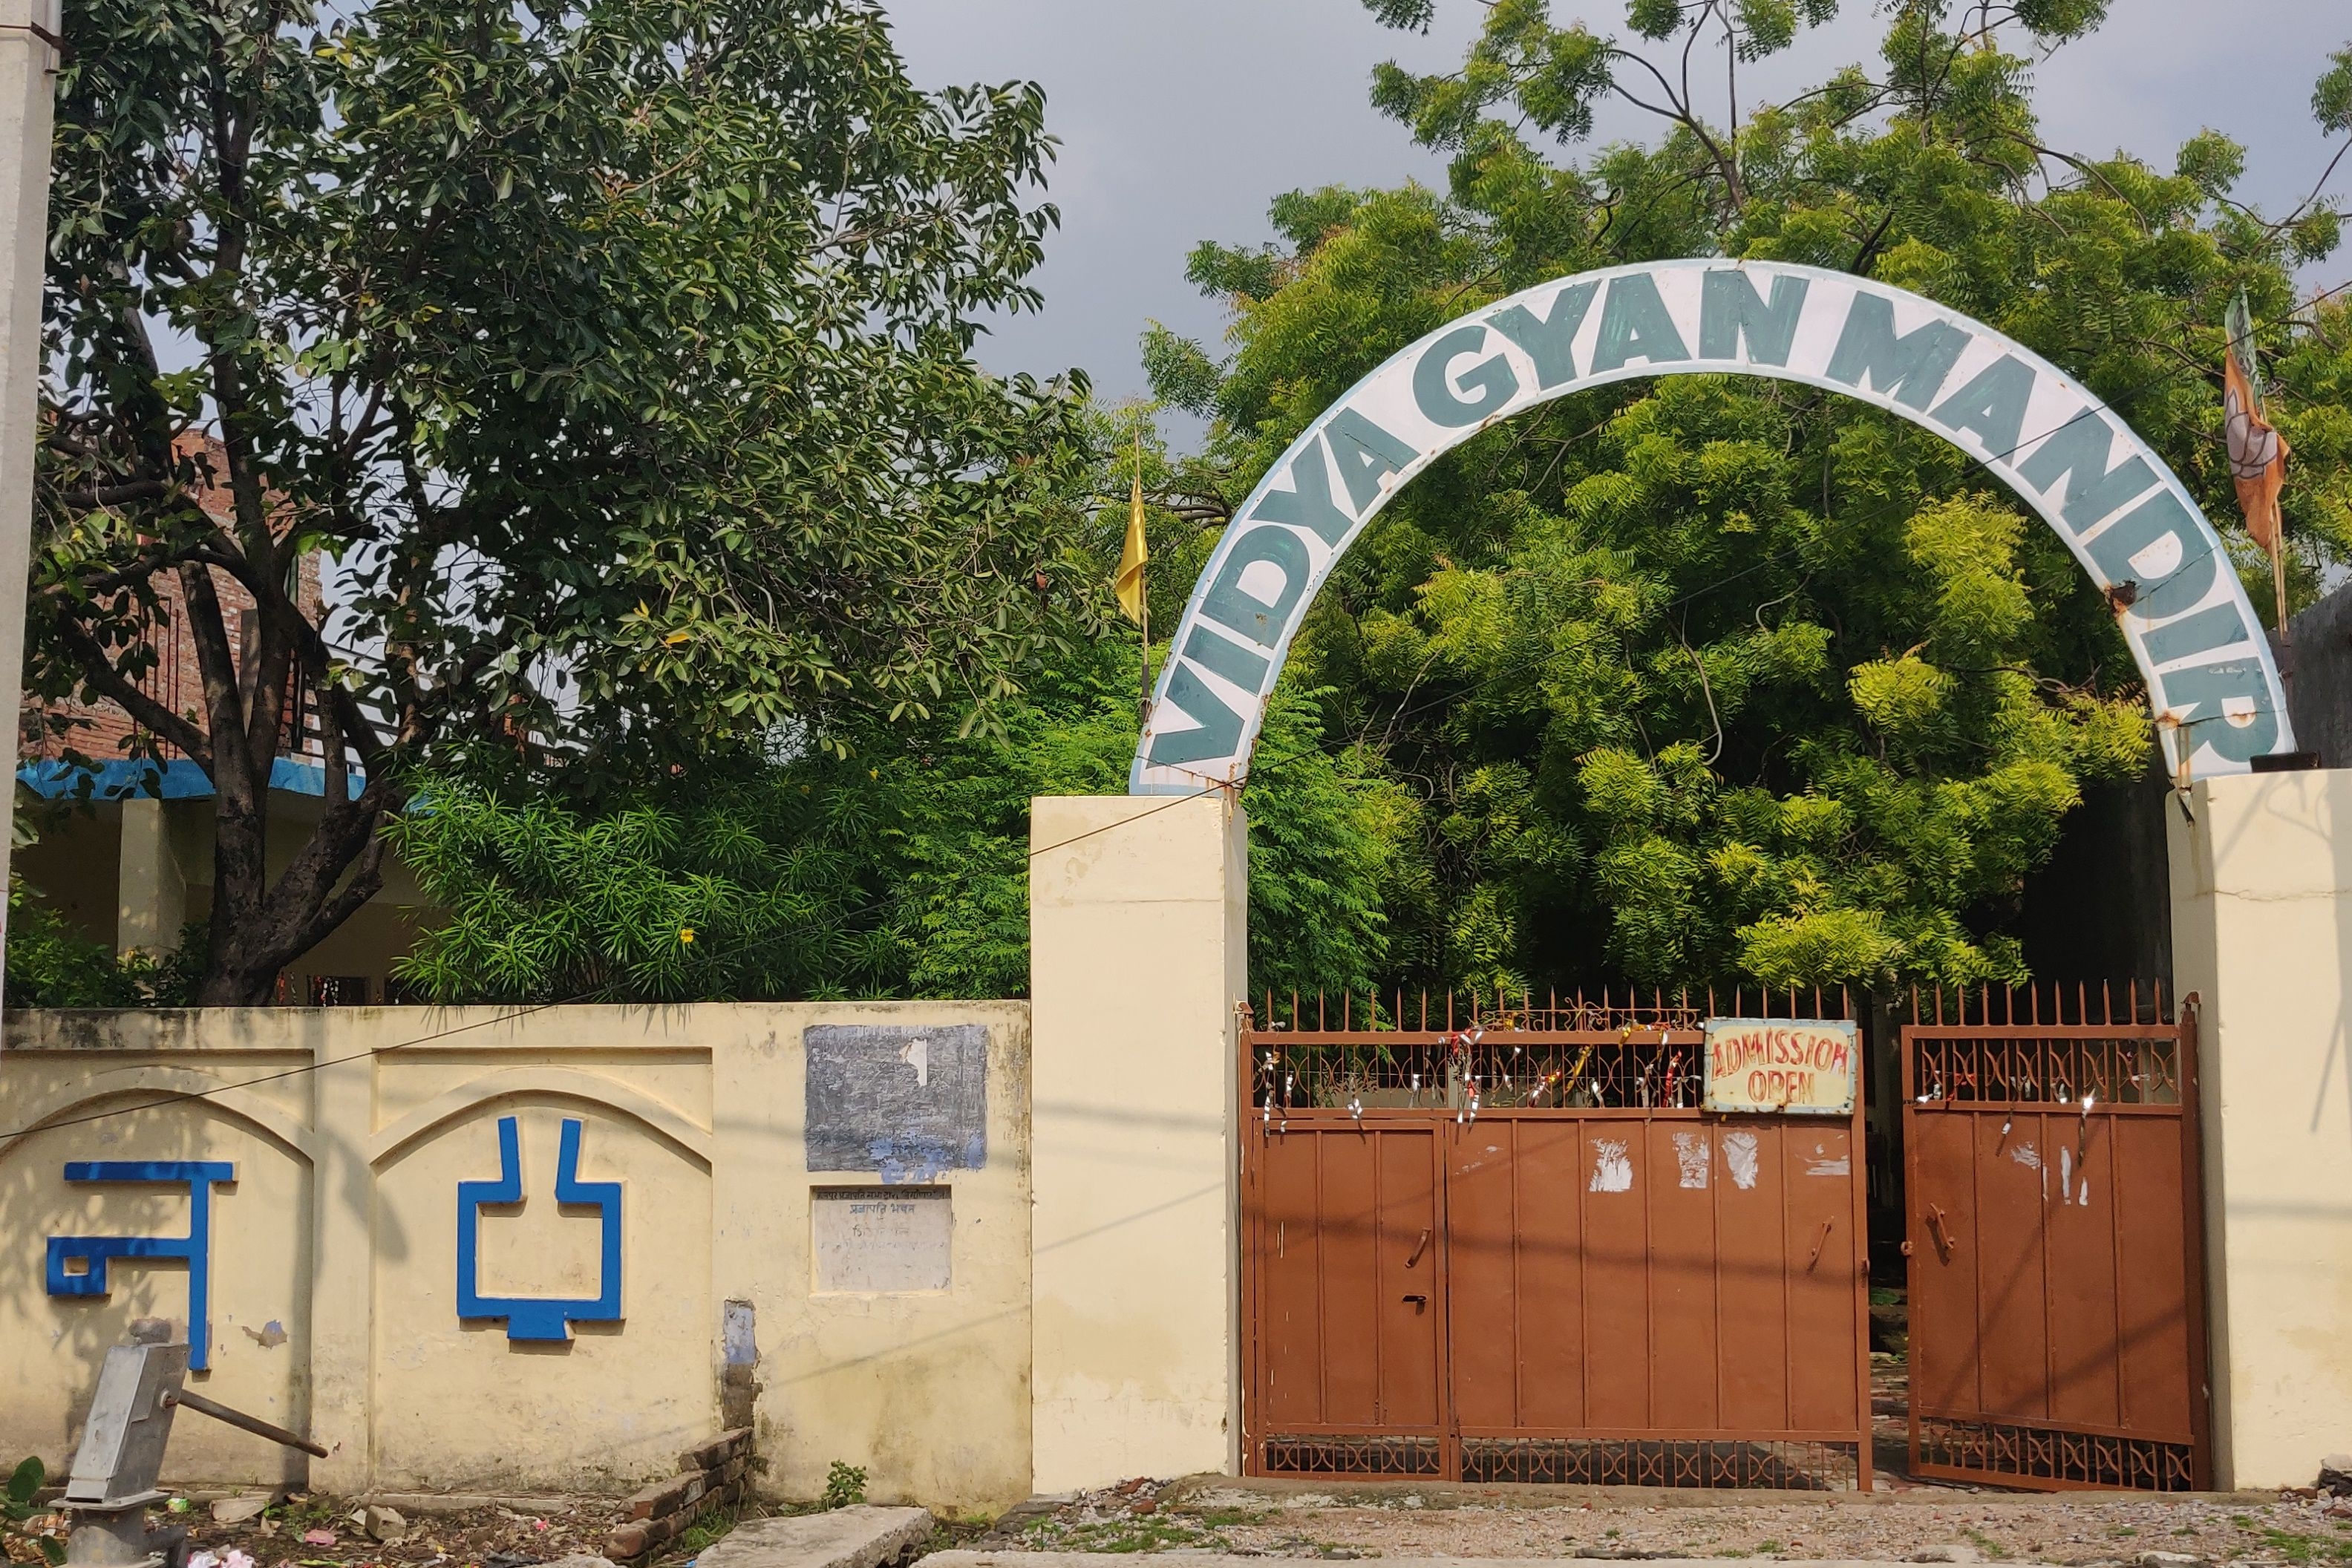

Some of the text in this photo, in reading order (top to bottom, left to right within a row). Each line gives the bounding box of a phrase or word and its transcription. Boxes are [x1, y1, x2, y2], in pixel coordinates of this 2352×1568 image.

[1146, 270, 2278, 770] VIDYA GYAN MANDIR
[1711, 1028, 1849, 1082] ADMISSION
[1747, 1070, 1815, 1103] OPEN
[849, 1201, 886, 1215] प्रजापति
